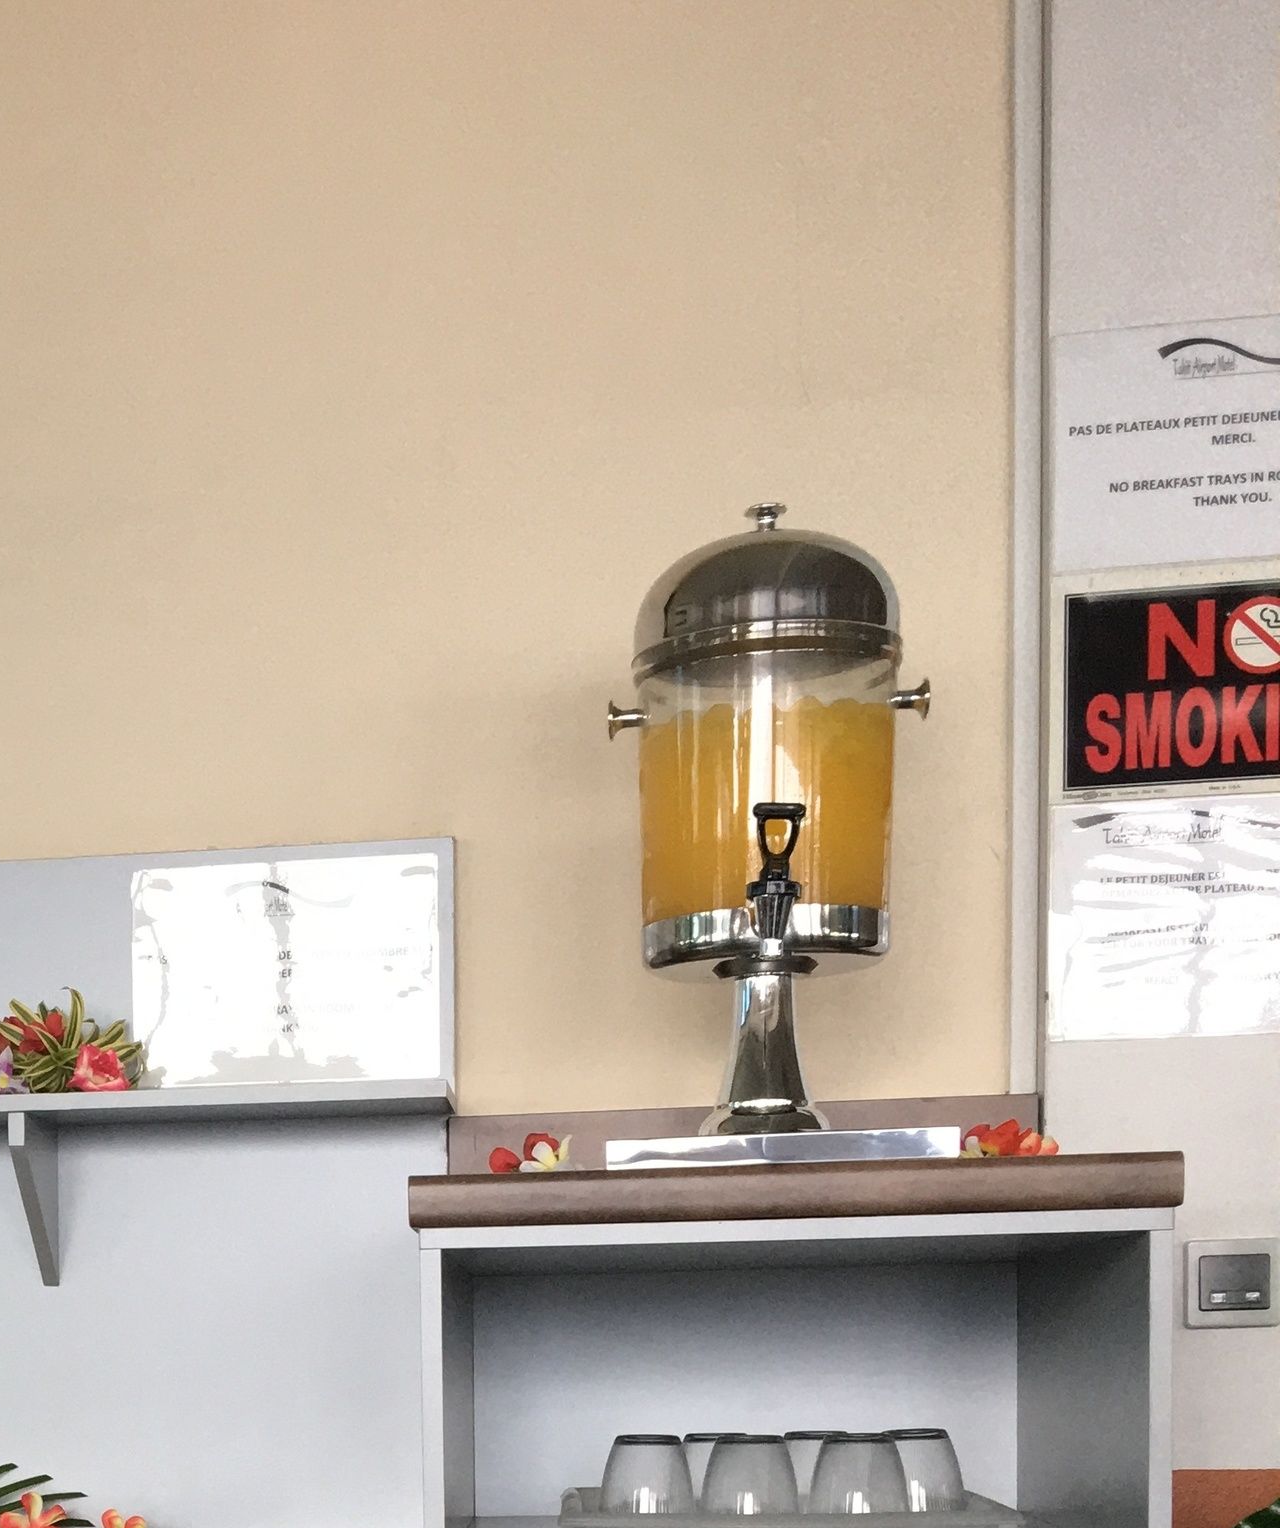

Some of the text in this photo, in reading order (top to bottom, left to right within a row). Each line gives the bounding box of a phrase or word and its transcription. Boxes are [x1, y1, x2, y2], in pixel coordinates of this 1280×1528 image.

[1069, 410, 1280, 437] PAS DE PLATEAUX PETIT DEJEUNE
[1211, 433, 1256, 445] MERCI.
[1109, 482, 1129, 493] NO
[1132, 475, 1203, 491] BREAKFAST
[1207, 474, 1247, 486] TRAYS
[1251, 472, 1264, 482] IN
[1193, 492, 1272, 507] THANK YOU.
[1150, 872, 1205, 884] DEJEUNER
